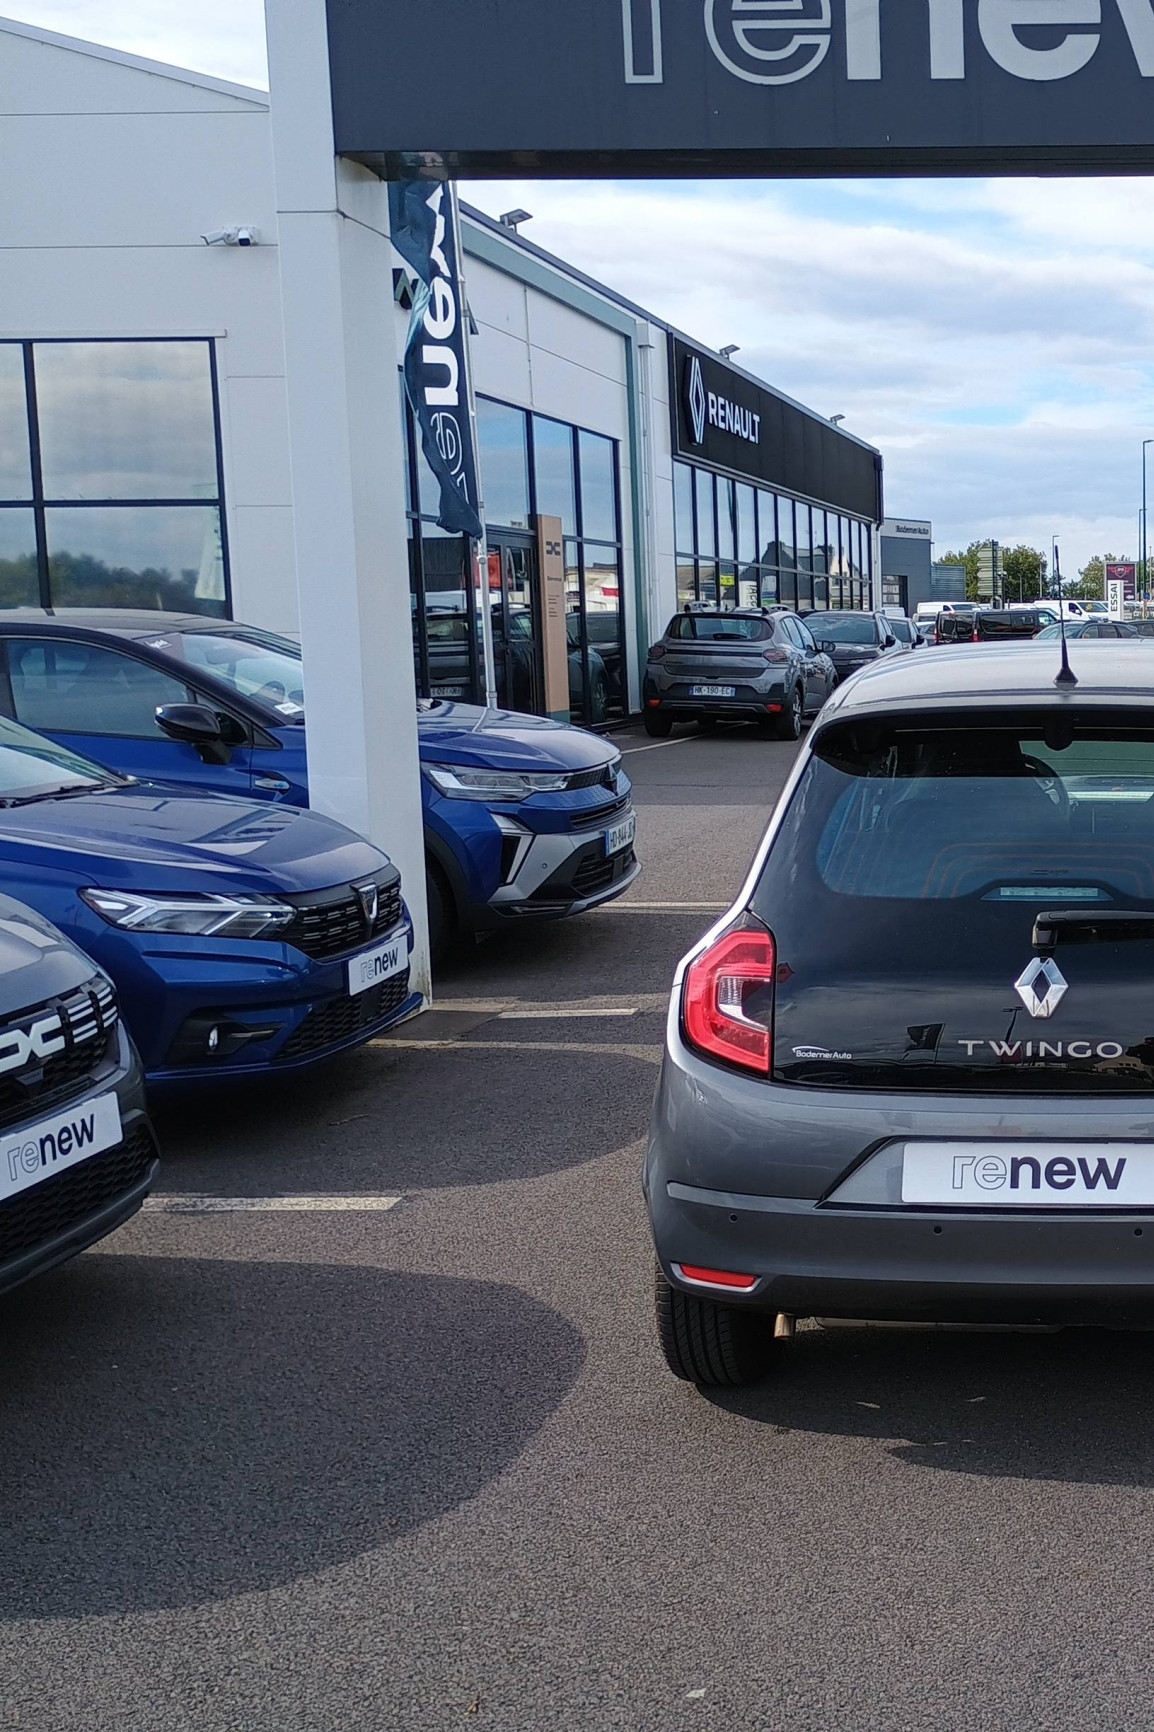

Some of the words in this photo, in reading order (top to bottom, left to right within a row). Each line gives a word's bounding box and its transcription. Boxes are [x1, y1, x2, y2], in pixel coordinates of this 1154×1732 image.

[708, 391, 760, 444] RENAULT
[1110, 583, 1118, 612] ESSAI
[361, 947, 398, 982] renew
[796, 1050, 852, 1059] BodemerAuto
[958, 1040, 1123, 1058] TWINGO
[7, 1113, 94, 1181] renew
[952, 1156, 1127, 1190] renew
